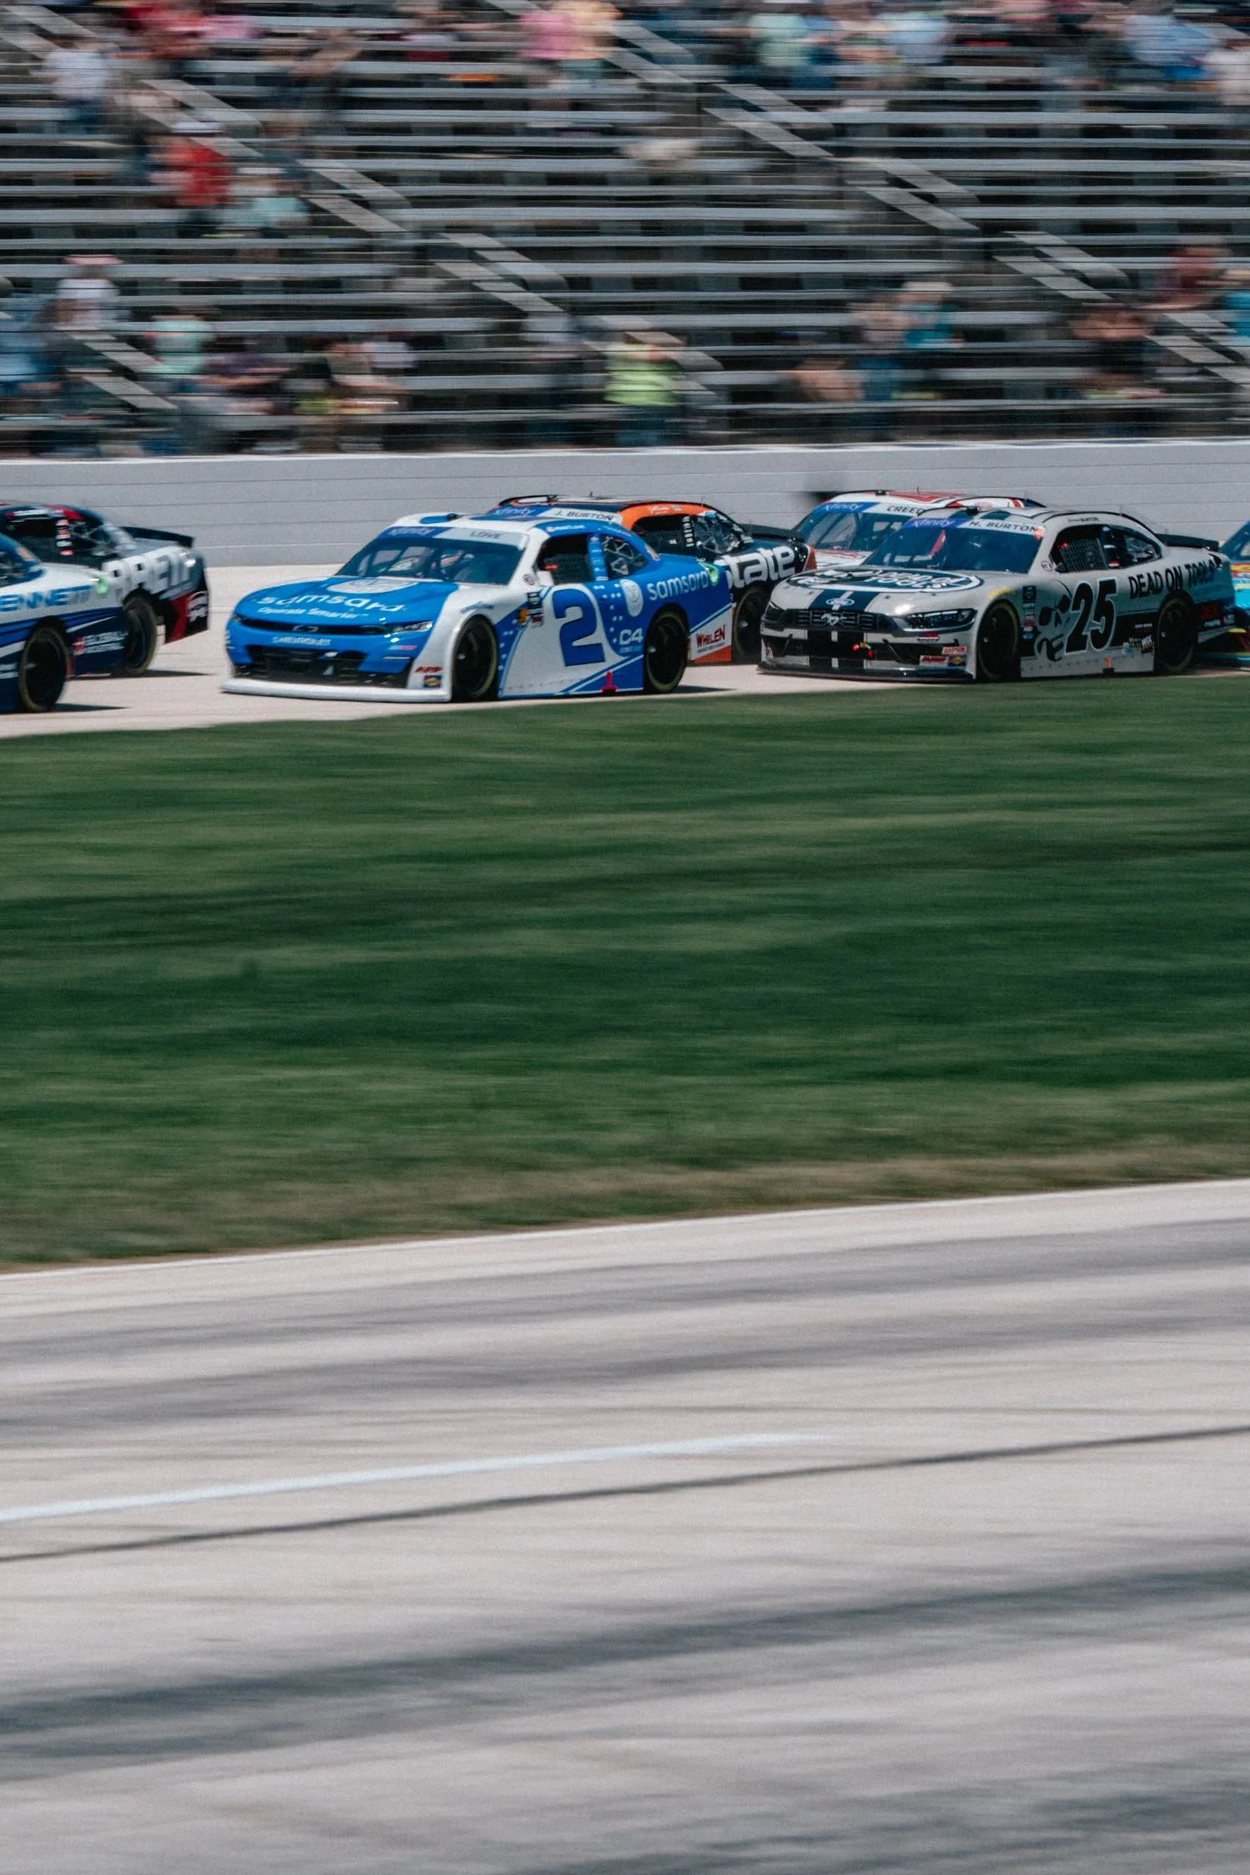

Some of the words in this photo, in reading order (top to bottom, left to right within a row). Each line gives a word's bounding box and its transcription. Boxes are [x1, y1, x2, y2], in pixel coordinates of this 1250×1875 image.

[494, 506, 535, 517] xfinity
[823, 502, 862, 512] xfinity
[887, 505, 924, 514] CREED
[566, 511, 615, 521] BURTON
[912, 518, 956, 528] xfinity
[986, 520, 1037, 532] BURTON
[470, 530, 501, 540] LOVE
[1128, 570, 1163, 600] DEAD
[1165, 565, 1184, 594] ON
[256, 594, 406, 612] samsara
[258, 607, 307, 615] Operate
[308, 607, 359, 619] Smarter
[1064, 577, 1119, 654] 25
[552, 588, 607, 667] 2
[619, 628, 644, 645] C4
[695, 625, 727, 648] WHELEN
